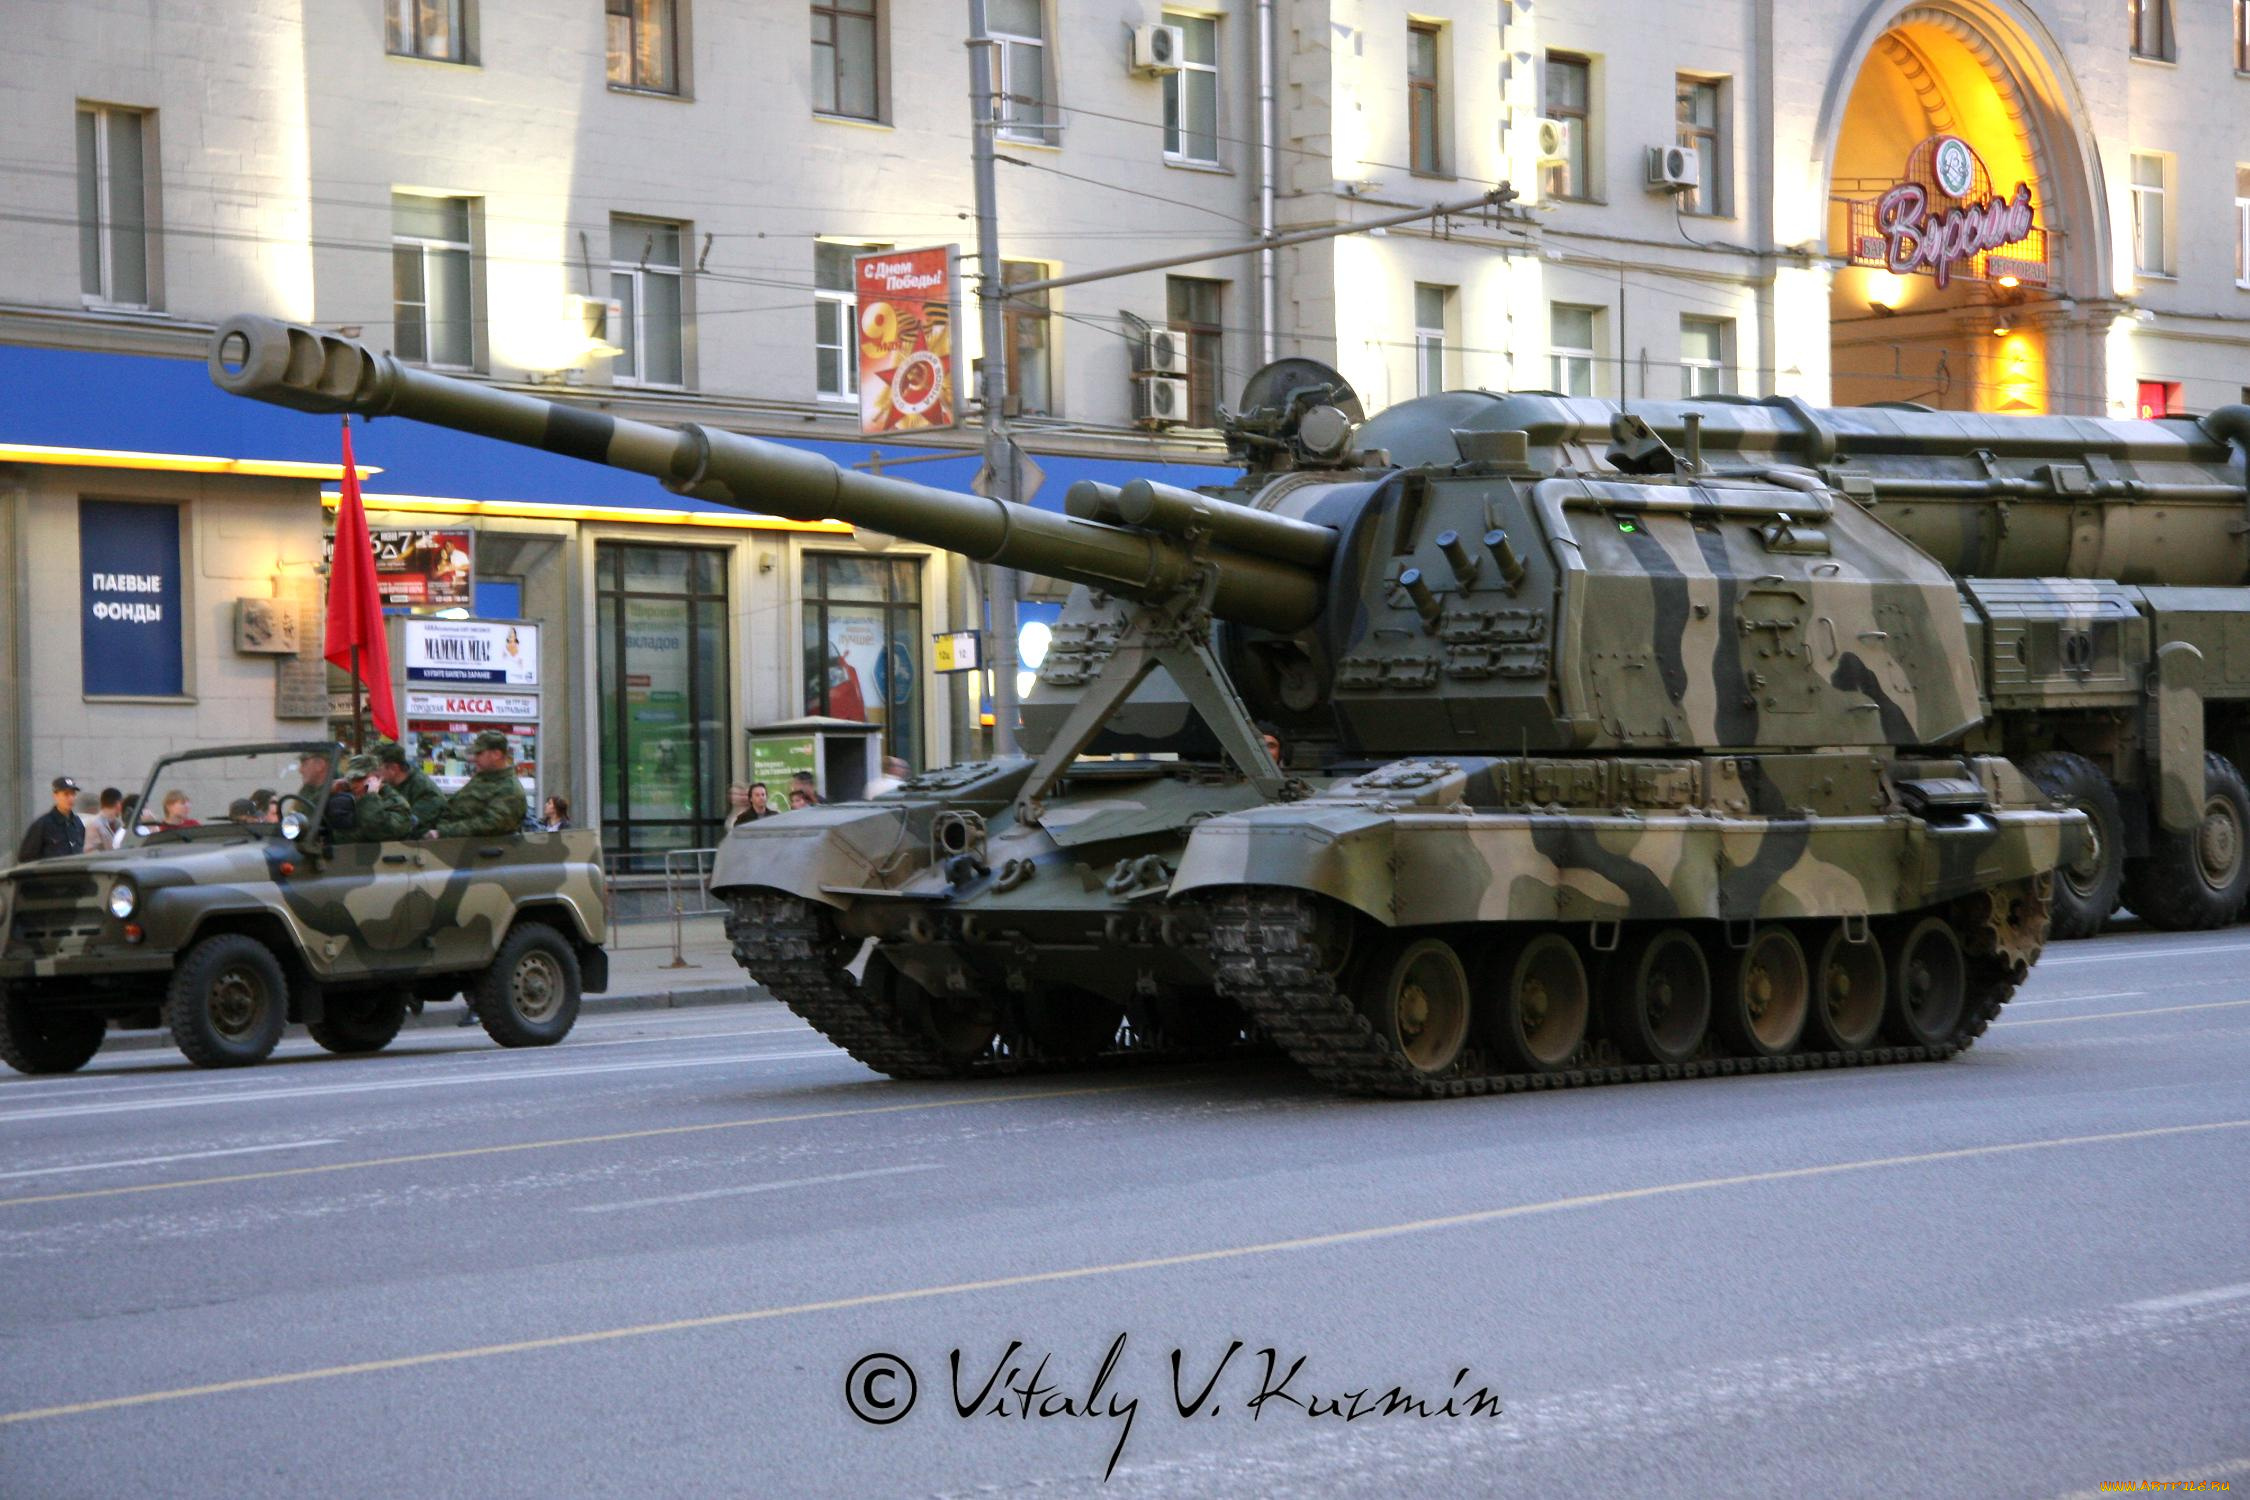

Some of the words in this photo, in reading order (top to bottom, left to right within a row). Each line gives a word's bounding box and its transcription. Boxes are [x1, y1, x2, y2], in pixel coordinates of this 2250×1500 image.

[1863, 239, 1886, 257] БАР
[875, 262, 913, 280] Днем
[886, 269, 942, 291] Победы!
[1989, 258, 2047, 281] РЕСТОРАН
[861, 301, 898, 359] 9
[92, 573, 161, 593] ПАЕВЫЕ
[92, 601, 162, 624] ФОНДЫ
[424, 638, 465, 661] MAMMA
[467, 639, 490, 662] MIA!
[445, 698, 494, 714] КАССА
